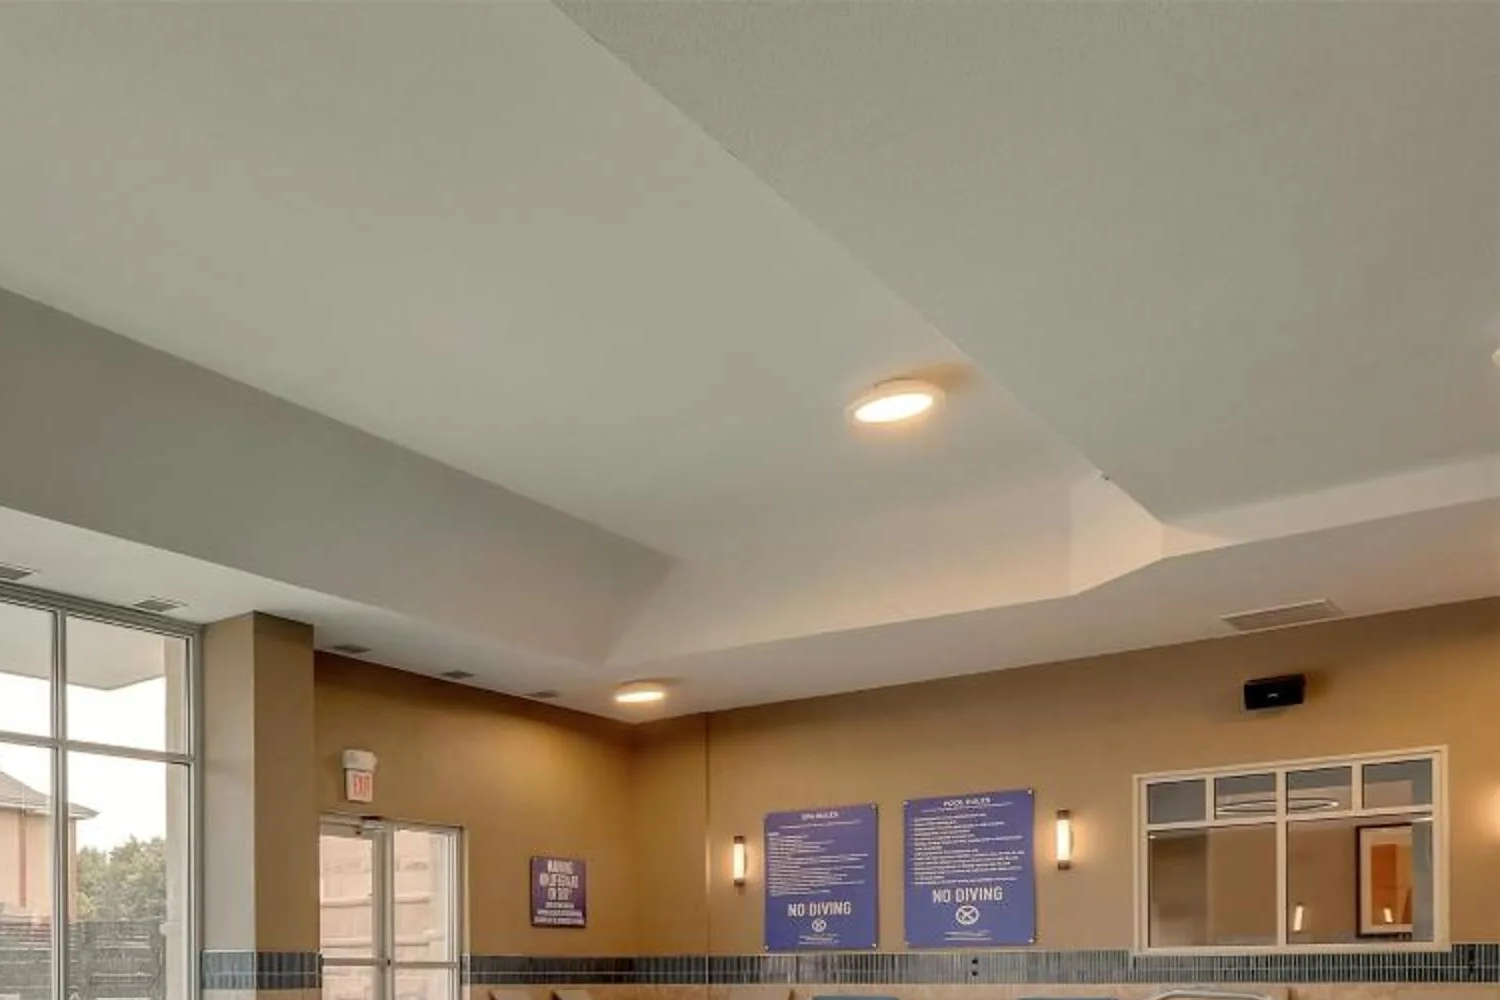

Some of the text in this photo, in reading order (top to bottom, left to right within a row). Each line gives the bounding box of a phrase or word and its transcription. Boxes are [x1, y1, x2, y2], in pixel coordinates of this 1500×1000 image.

[931, 885, 1004, 904] NO DIVING
[787, 900, 852, 917] NO DIVING
